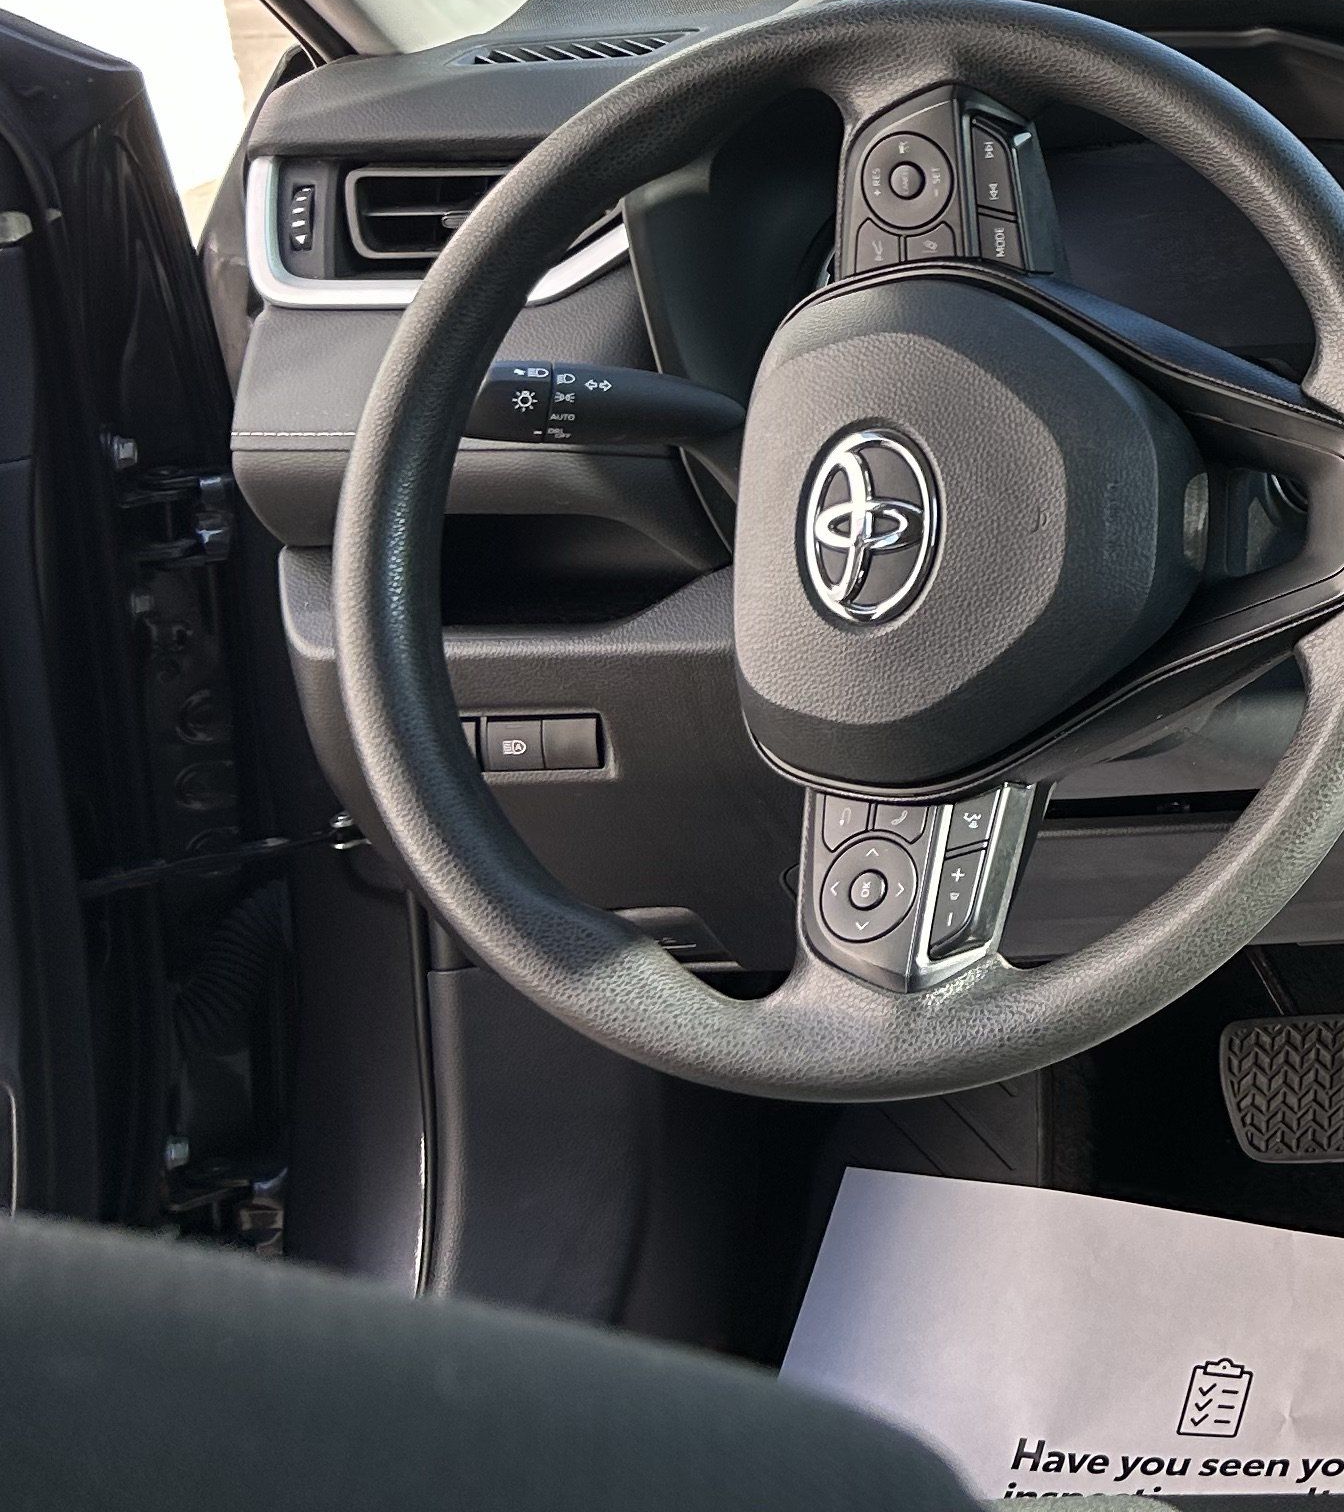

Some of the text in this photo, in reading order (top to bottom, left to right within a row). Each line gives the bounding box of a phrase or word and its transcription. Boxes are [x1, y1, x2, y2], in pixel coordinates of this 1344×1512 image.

[994, 227, 1006, 258] MODE
[549, 413, 576, 421] AUTO
[859, 881, 871, 898] OK
[1010, 1437, 1110, 1475] Have
[1113, 1454, 1192, 1483] you
[1198, 1457, 1291, 1477] seen
